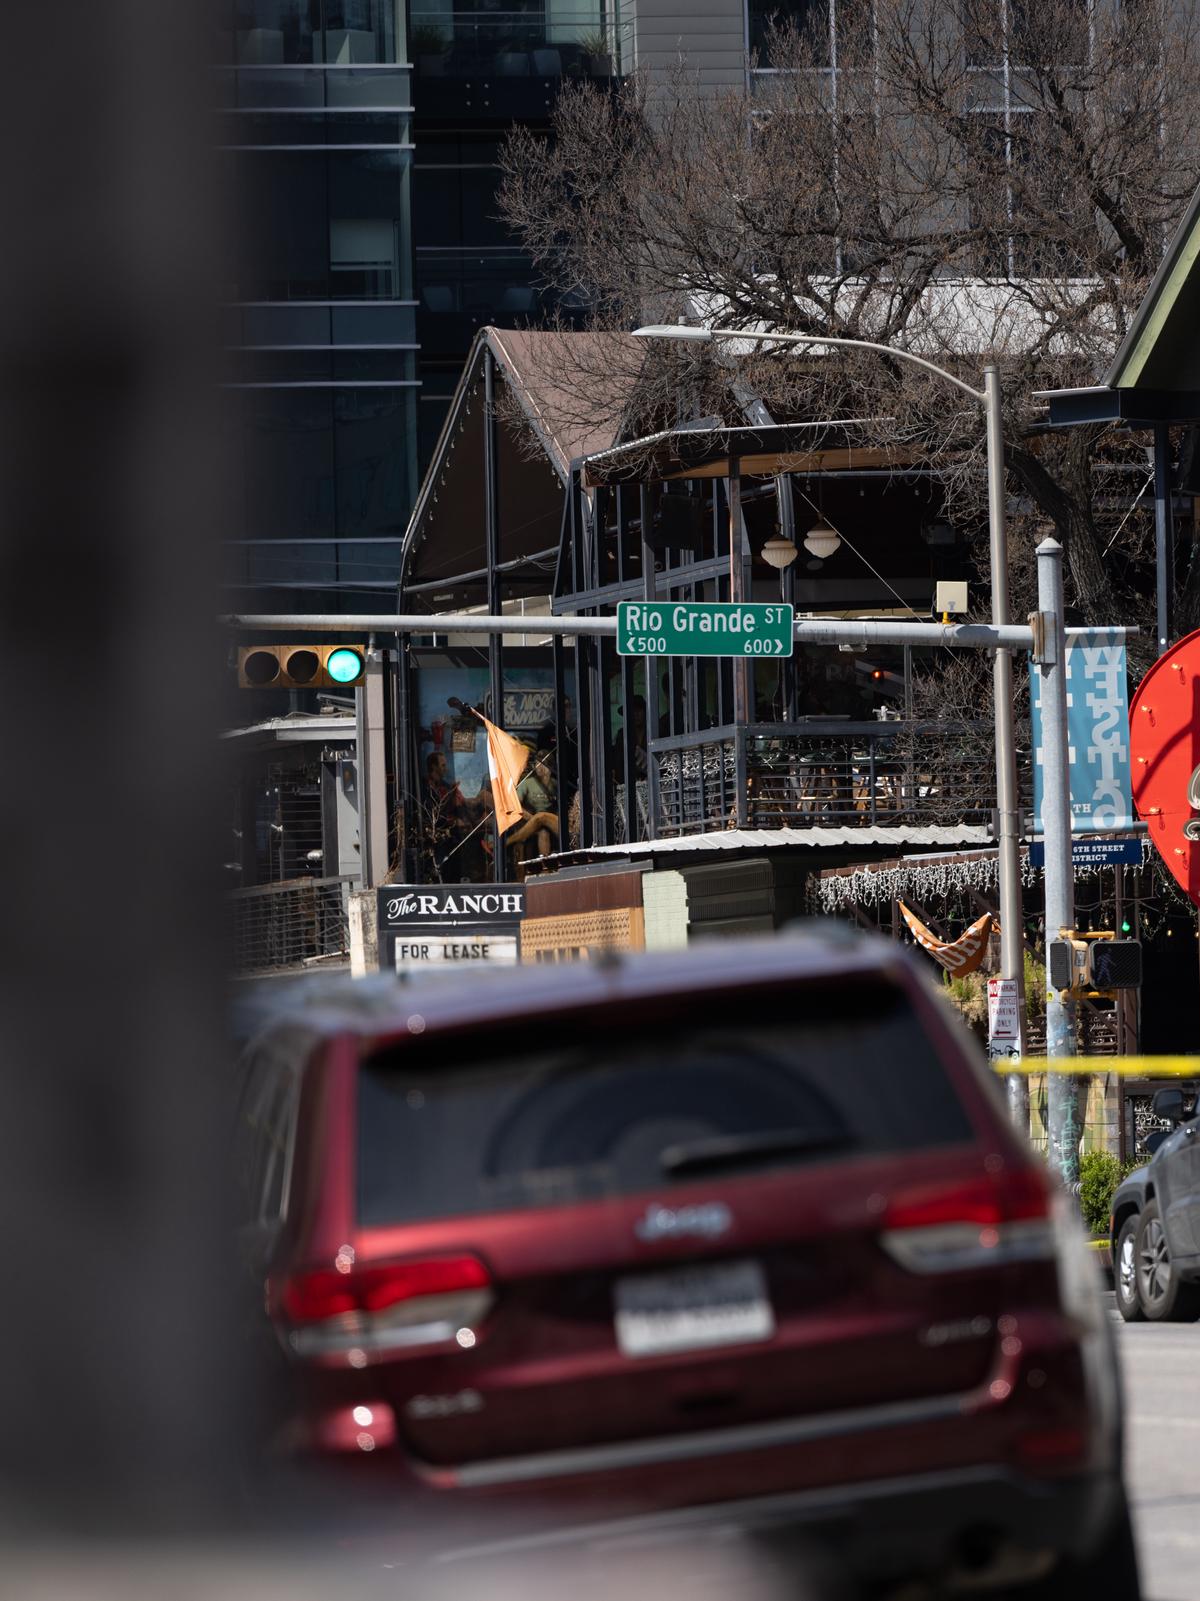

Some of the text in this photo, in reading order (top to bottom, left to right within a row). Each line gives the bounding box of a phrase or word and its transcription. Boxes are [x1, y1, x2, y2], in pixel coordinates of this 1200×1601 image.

[626, 605, 784, 633] Rio Grande ST
[637, 637, 773, 654] 500 600
[1073, 803, 1092, 814] TH
[1073, 844, 1125, 853] 6TH STREET
[1072, 854, 1108, 862] ISTRICT
[387, 893, 523, 919] The RANCH
[401, 944, 489, 960] FOR LEASE
[992, 1007, 1016, 1016] PARKING
